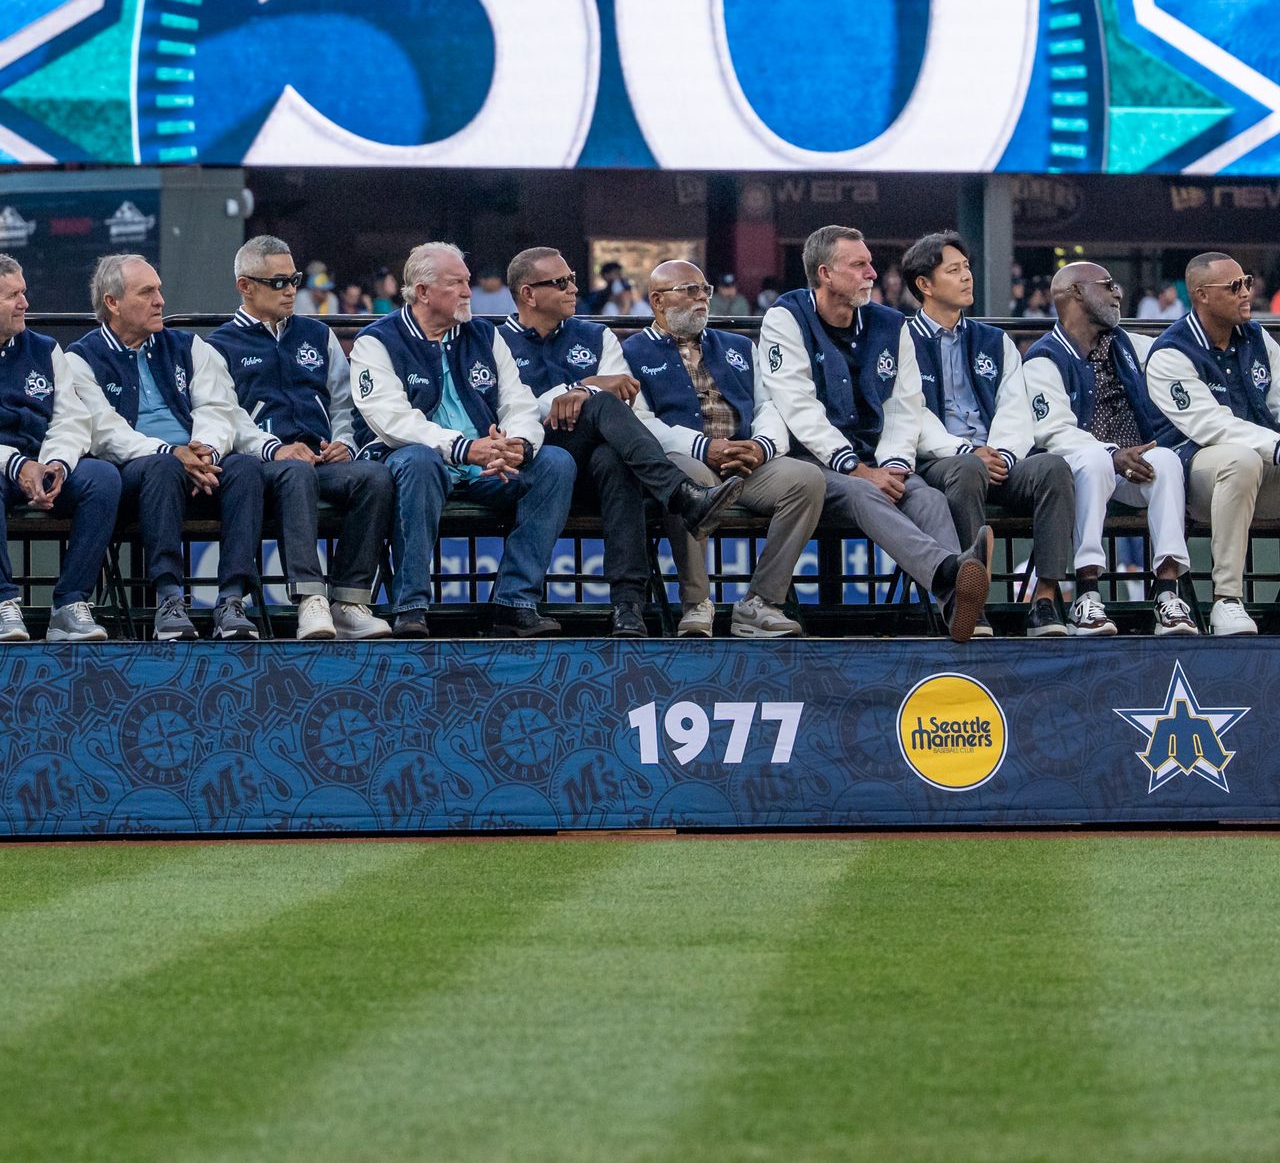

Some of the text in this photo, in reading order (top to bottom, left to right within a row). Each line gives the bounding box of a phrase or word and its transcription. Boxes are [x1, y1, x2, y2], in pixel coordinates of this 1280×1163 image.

[300, 349, 317, 361] 50
[573, 350, 590, 360] 50
[240, 357, 263, 367] Ichiro
[880, 358, 893, 370] 50
[977, 359, 993, 370] 50
[473, 369, 490, 381] 50
[641, 362, 668, 376] Ruppert
[1253, 367, 1267, 380] 50
[28, 377, 46, 389] 50
[407, 374, 430, 385] Norm
[929, 716, 991, 734] Seattle
[628, 700, 805, 765] 1977
